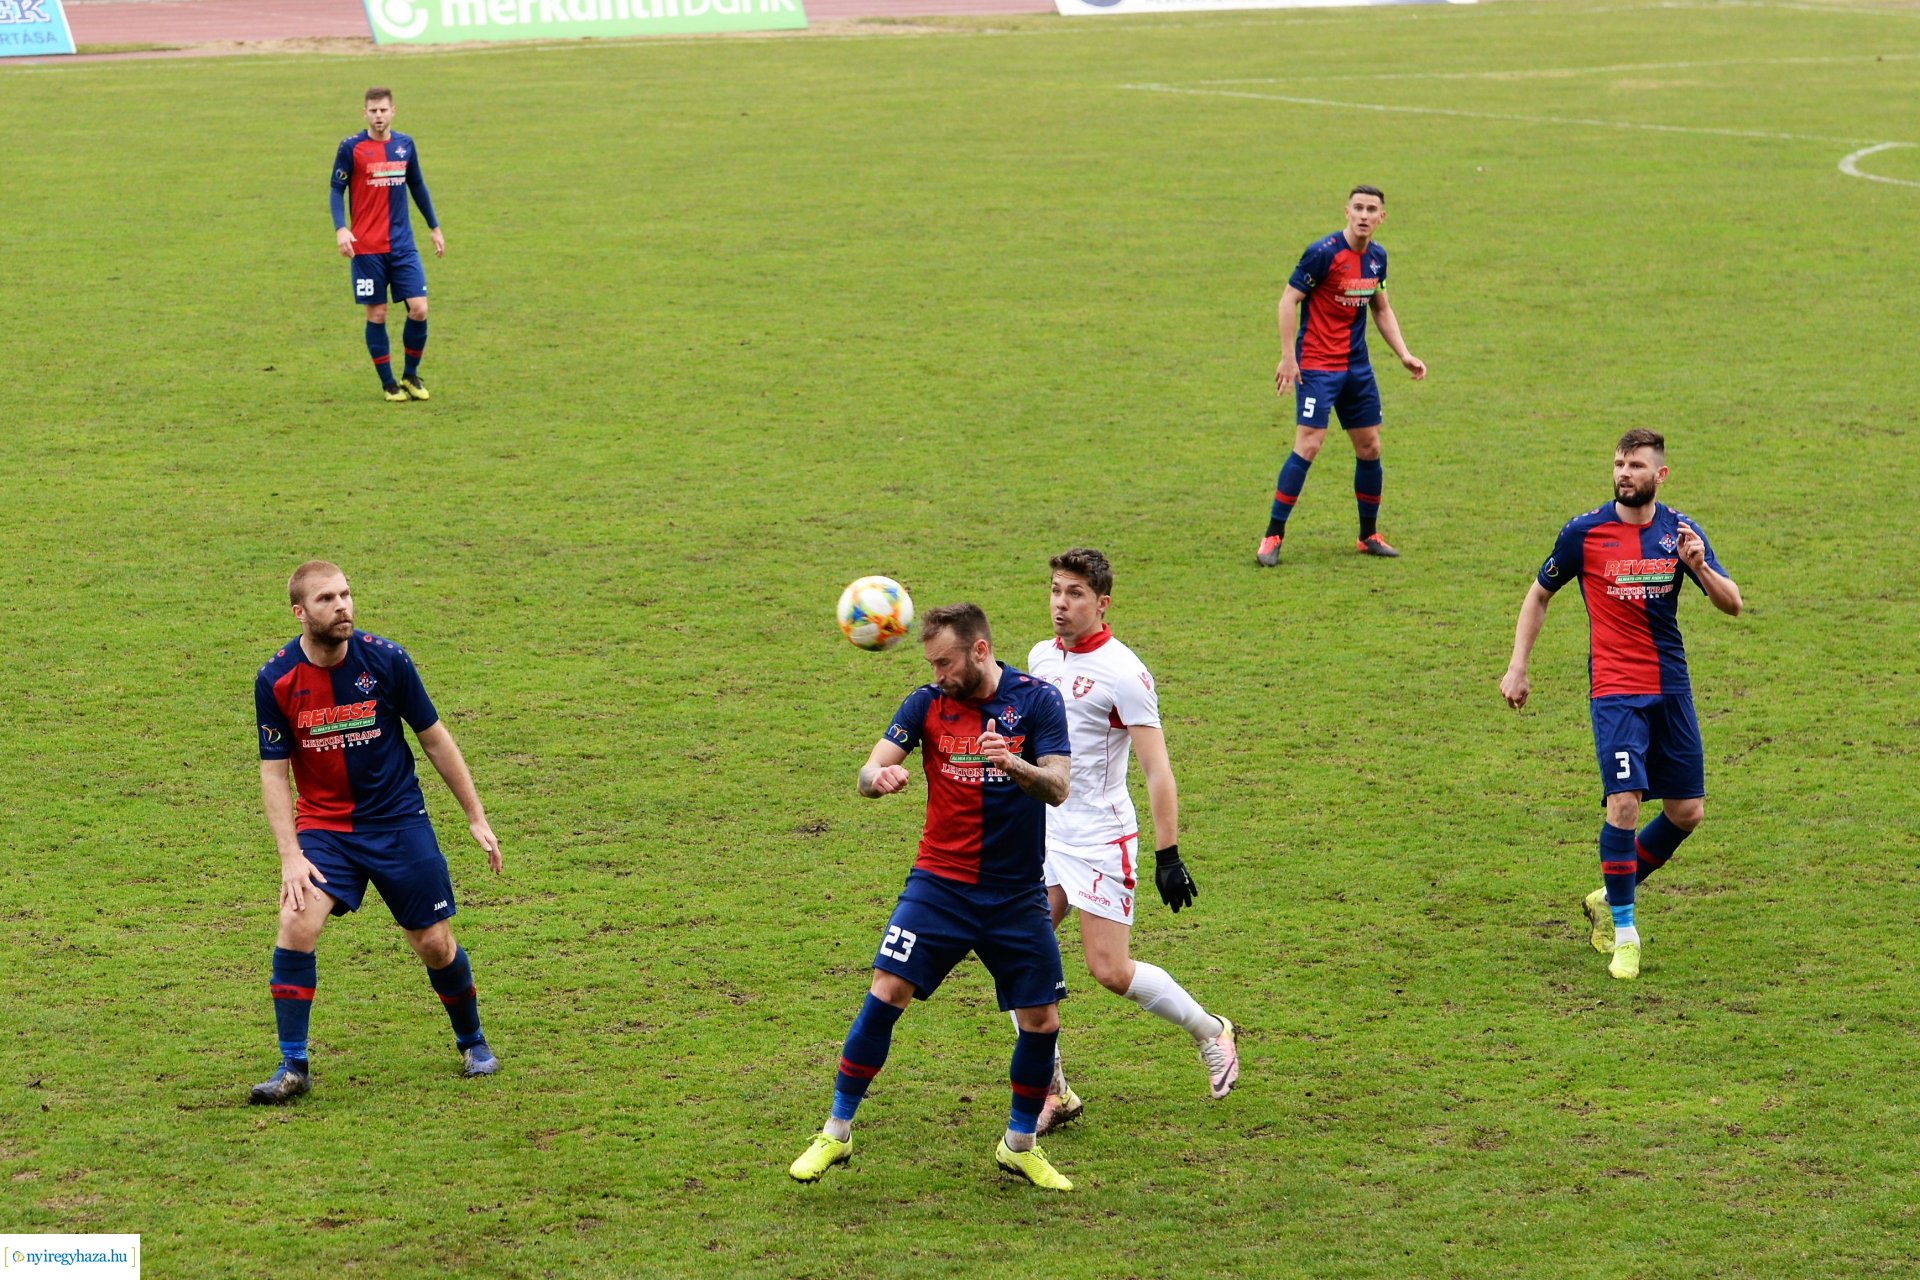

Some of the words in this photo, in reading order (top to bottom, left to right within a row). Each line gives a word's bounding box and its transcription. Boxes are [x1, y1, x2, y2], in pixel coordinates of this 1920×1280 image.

[356, 278, 375, 297] 28
[1302, 396, 1317, 419] 5
[1604, 559, 1678, 576] REVESZ
[298, 700, 377, 728] REVESZ
[939, 735, 1025, 754] REVZ
[1614, 751, 1631, 780] 3
[880, 924, 917, 963] 23
